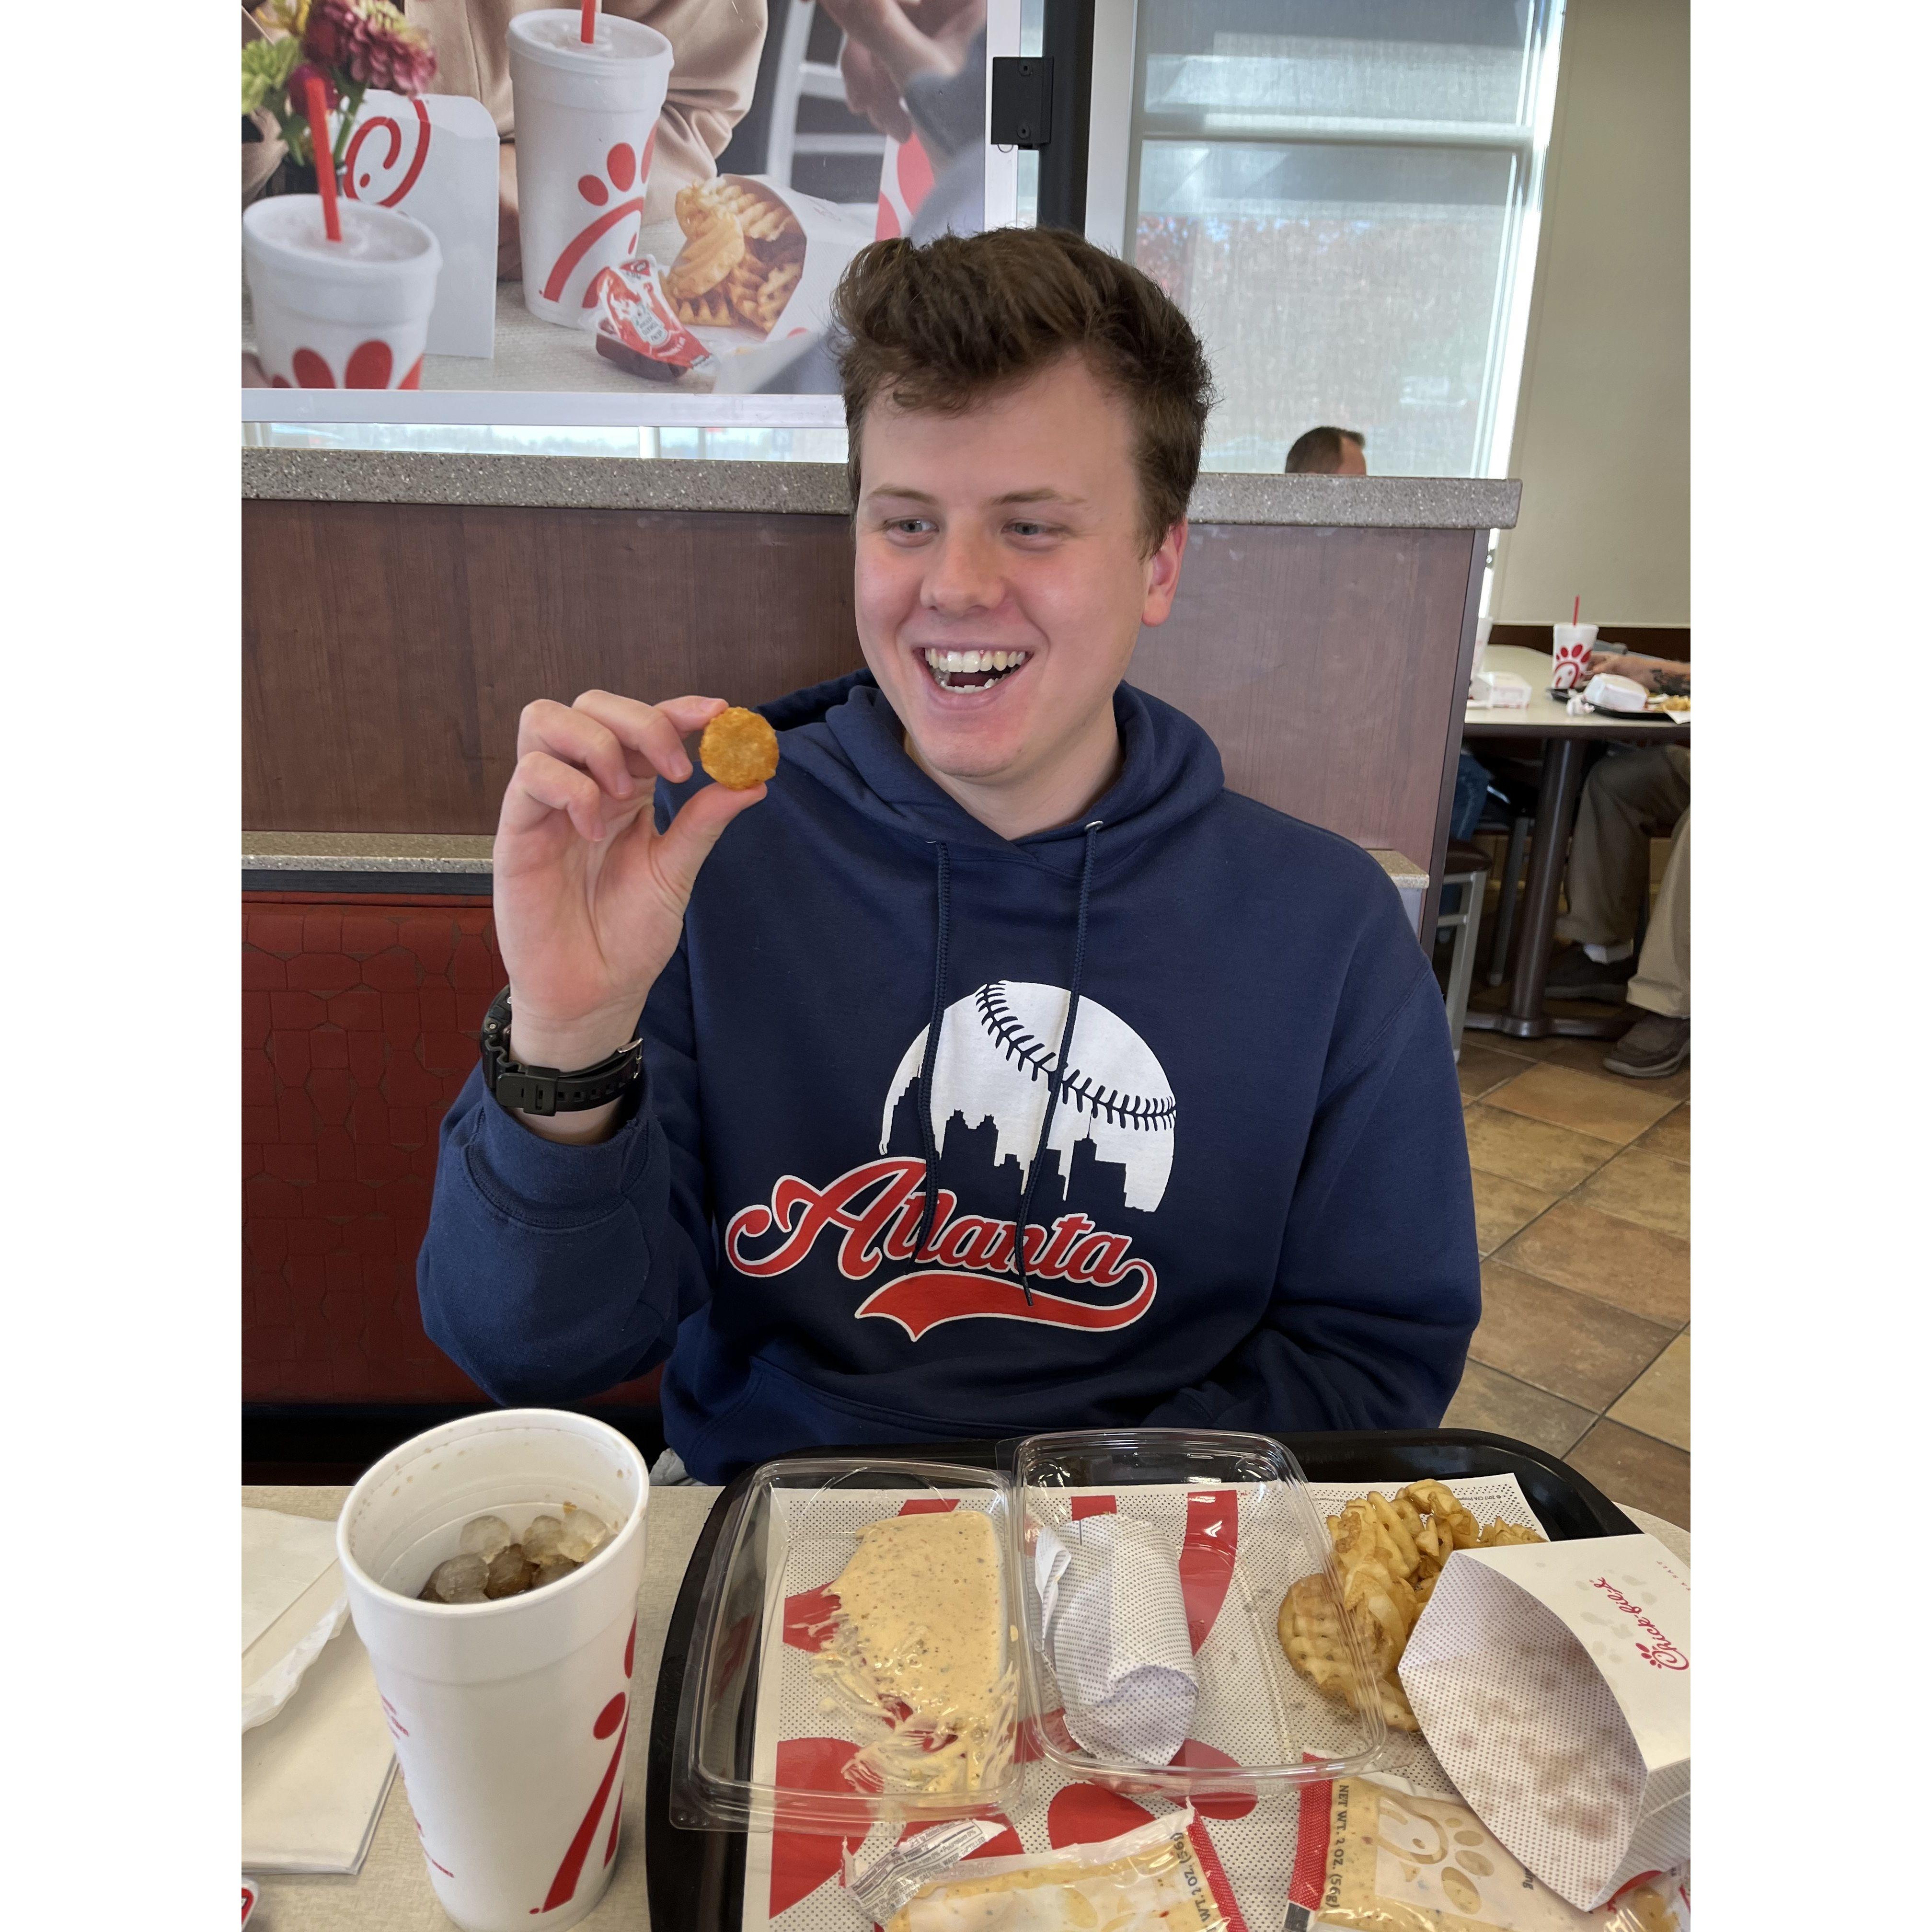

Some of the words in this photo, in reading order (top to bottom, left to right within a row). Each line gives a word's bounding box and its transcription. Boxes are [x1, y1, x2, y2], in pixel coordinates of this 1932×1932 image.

[725, 1156, 1157, 1291] Atlanta
[1594, 1577, 1690, 1670] Chick-fil-A
[1338, 1785, 1349, 1807] NET
[1335, 1810, 1347, 1835] WT.
[1332, 1849, 1345, 1869] OZ.
[1184, 1864, 1198, 1886] OZ.
[1191, 1887, 1202, 1896] 2
[1325, 1873, 1343, 1908] (56g)
[1195, 1895, 1211, 1922] WT.
